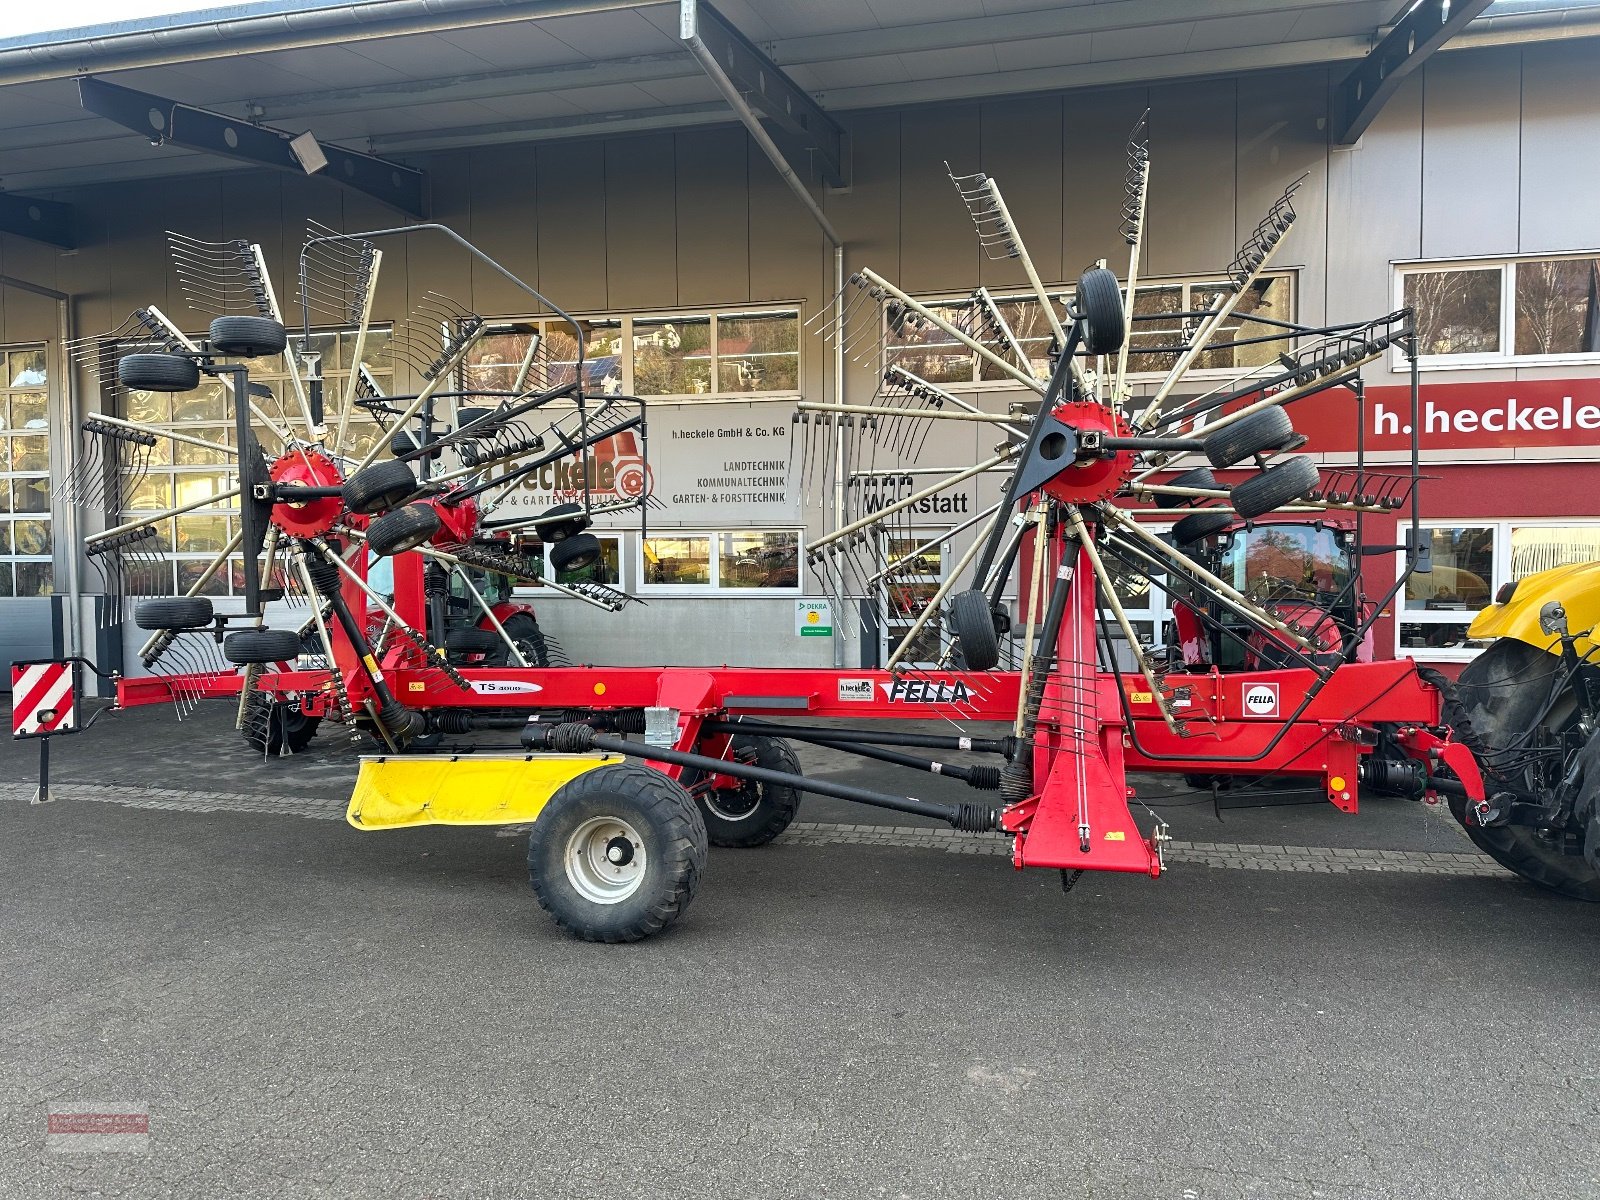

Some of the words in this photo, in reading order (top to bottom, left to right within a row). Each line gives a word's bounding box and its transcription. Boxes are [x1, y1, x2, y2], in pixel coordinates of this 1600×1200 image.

[1425, 396, 1600, 434] heckele
[717, 428, 743, 438] GmbH
[745, 427, 753, 437] &
[755, 427, 770, 437] Co.
[772, 426, 785, 437] KG
[723, 460, 785, 472] LANDTECHNIK
[697, 477, 785, 488] KOMMUNALTECHNIK
[672, 494, 710, 504] GARTEN-
[711, 493, 718, 503] &
[720, 492, 785, 503] FORSTTECHNIK
[479, 683, 496, 691] TS
[888, 680, 971, 703] FELLA
[1247, 695, 1274, 704] FELLA
